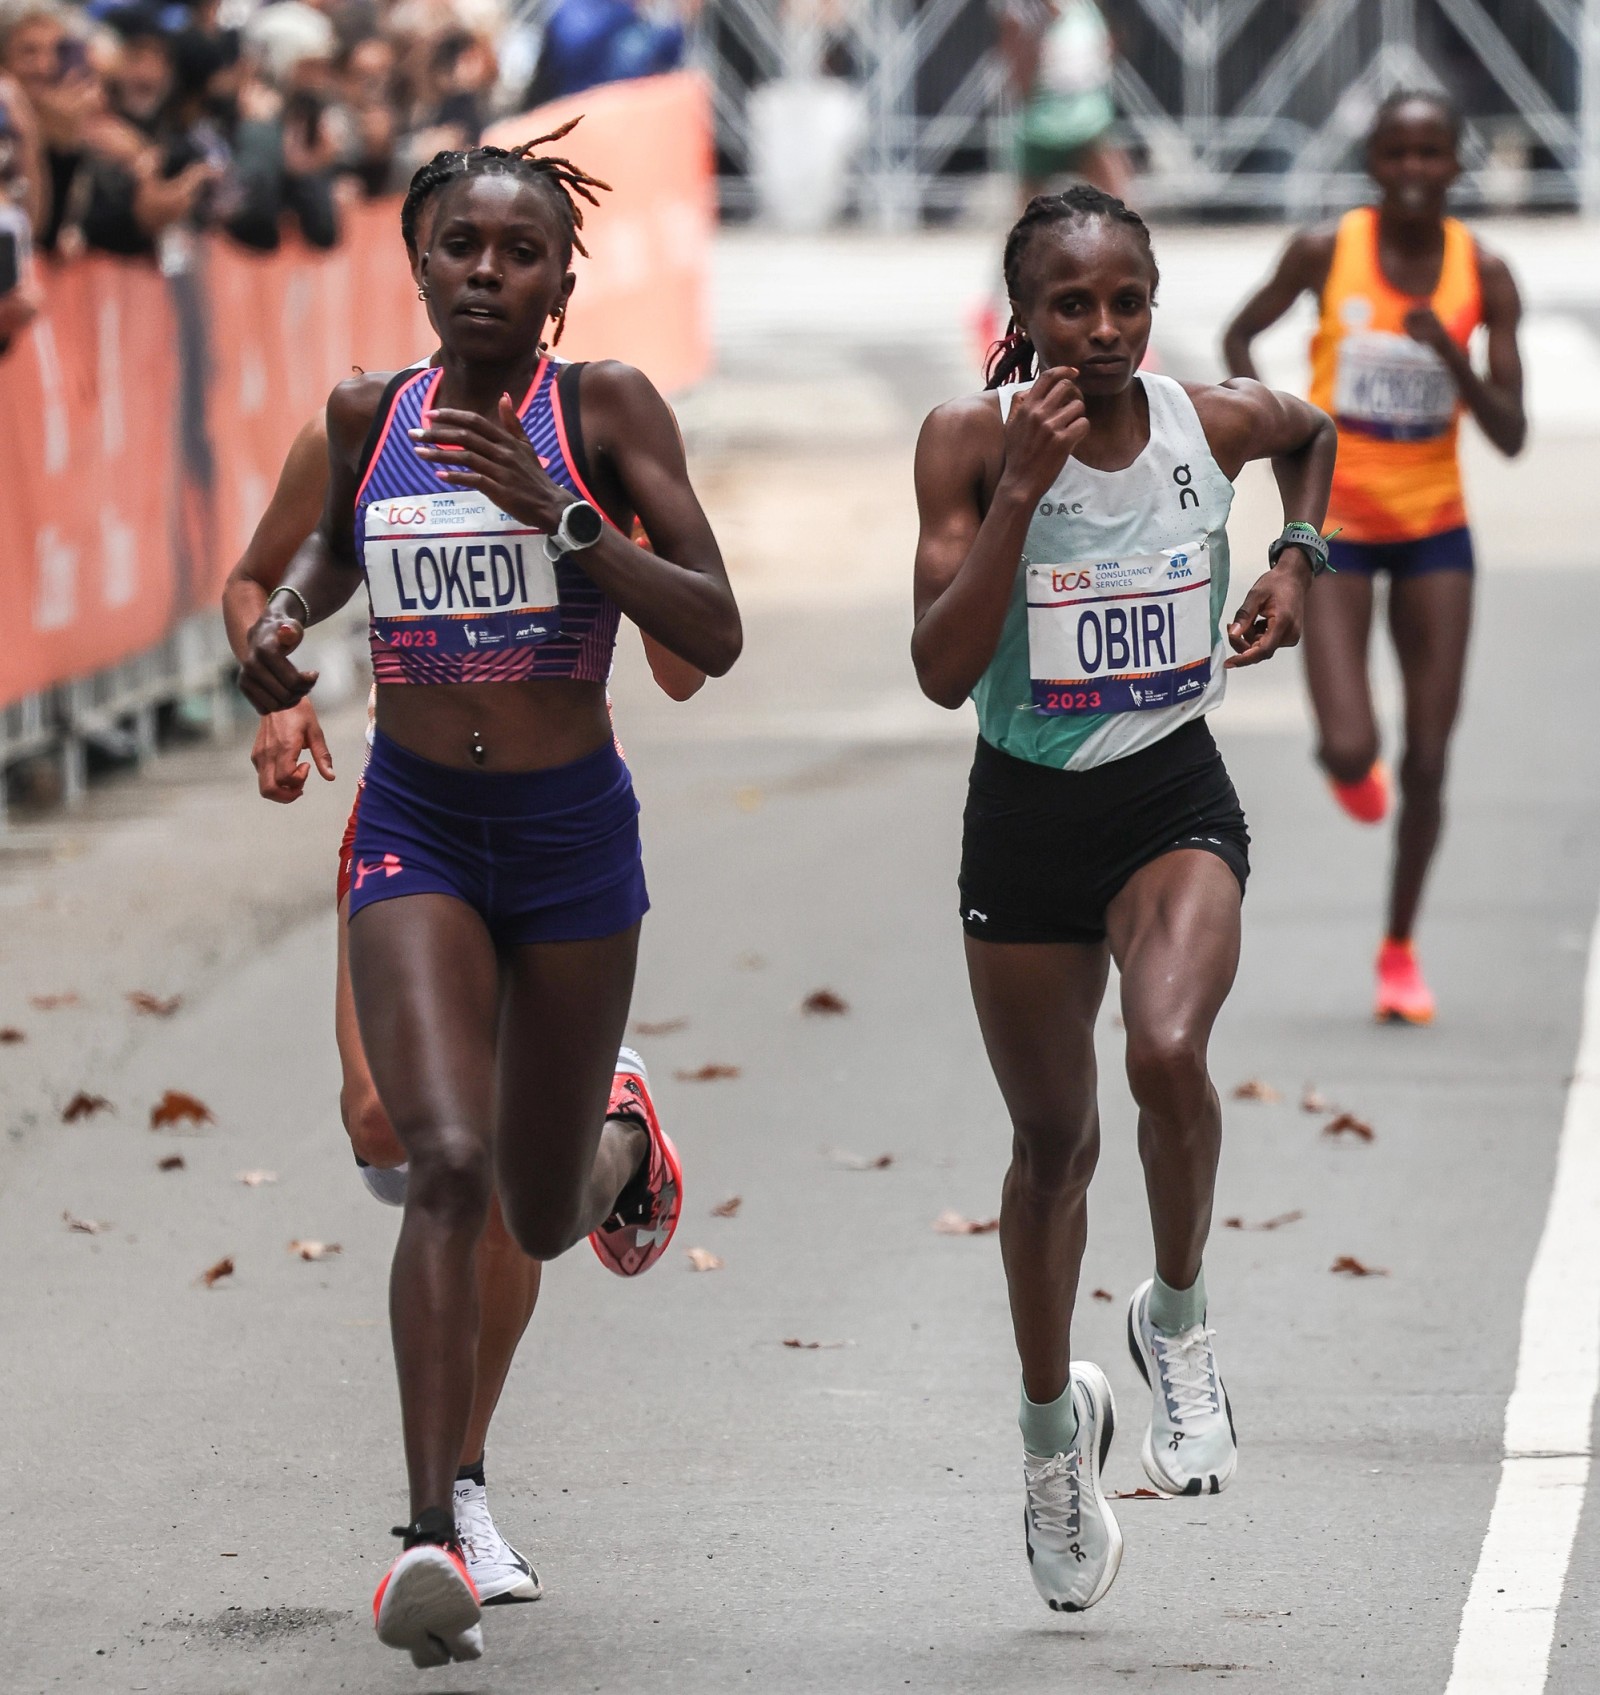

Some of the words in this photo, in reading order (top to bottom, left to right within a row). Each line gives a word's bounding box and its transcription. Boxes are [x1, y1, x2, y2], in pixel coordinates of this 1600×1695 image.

[432, 499, 455, 507] TATA
[1039, 502, 1084, 517] OAC
[388, 504, 426, 525] tcs
[430, 506, 486, 516] CONSULTANCY
[429, 516, 465, 525] SERVICES
[1095, 562, 1120, 571] TATA
[1095, 566, 1153, 580] CONSULTANCY
[391, 544, 528, 610] LOKEDI
[1052, 569, 1092, 593] tcs
[1167, 568, 1192, 580] TATA
[1095, 578, 1133, 589] SERVICES
[390, 630, 437, 646] 2023
[1076, 602, 1177, 674] OBIRI
[1047, 691, 1102, 710] 2023
